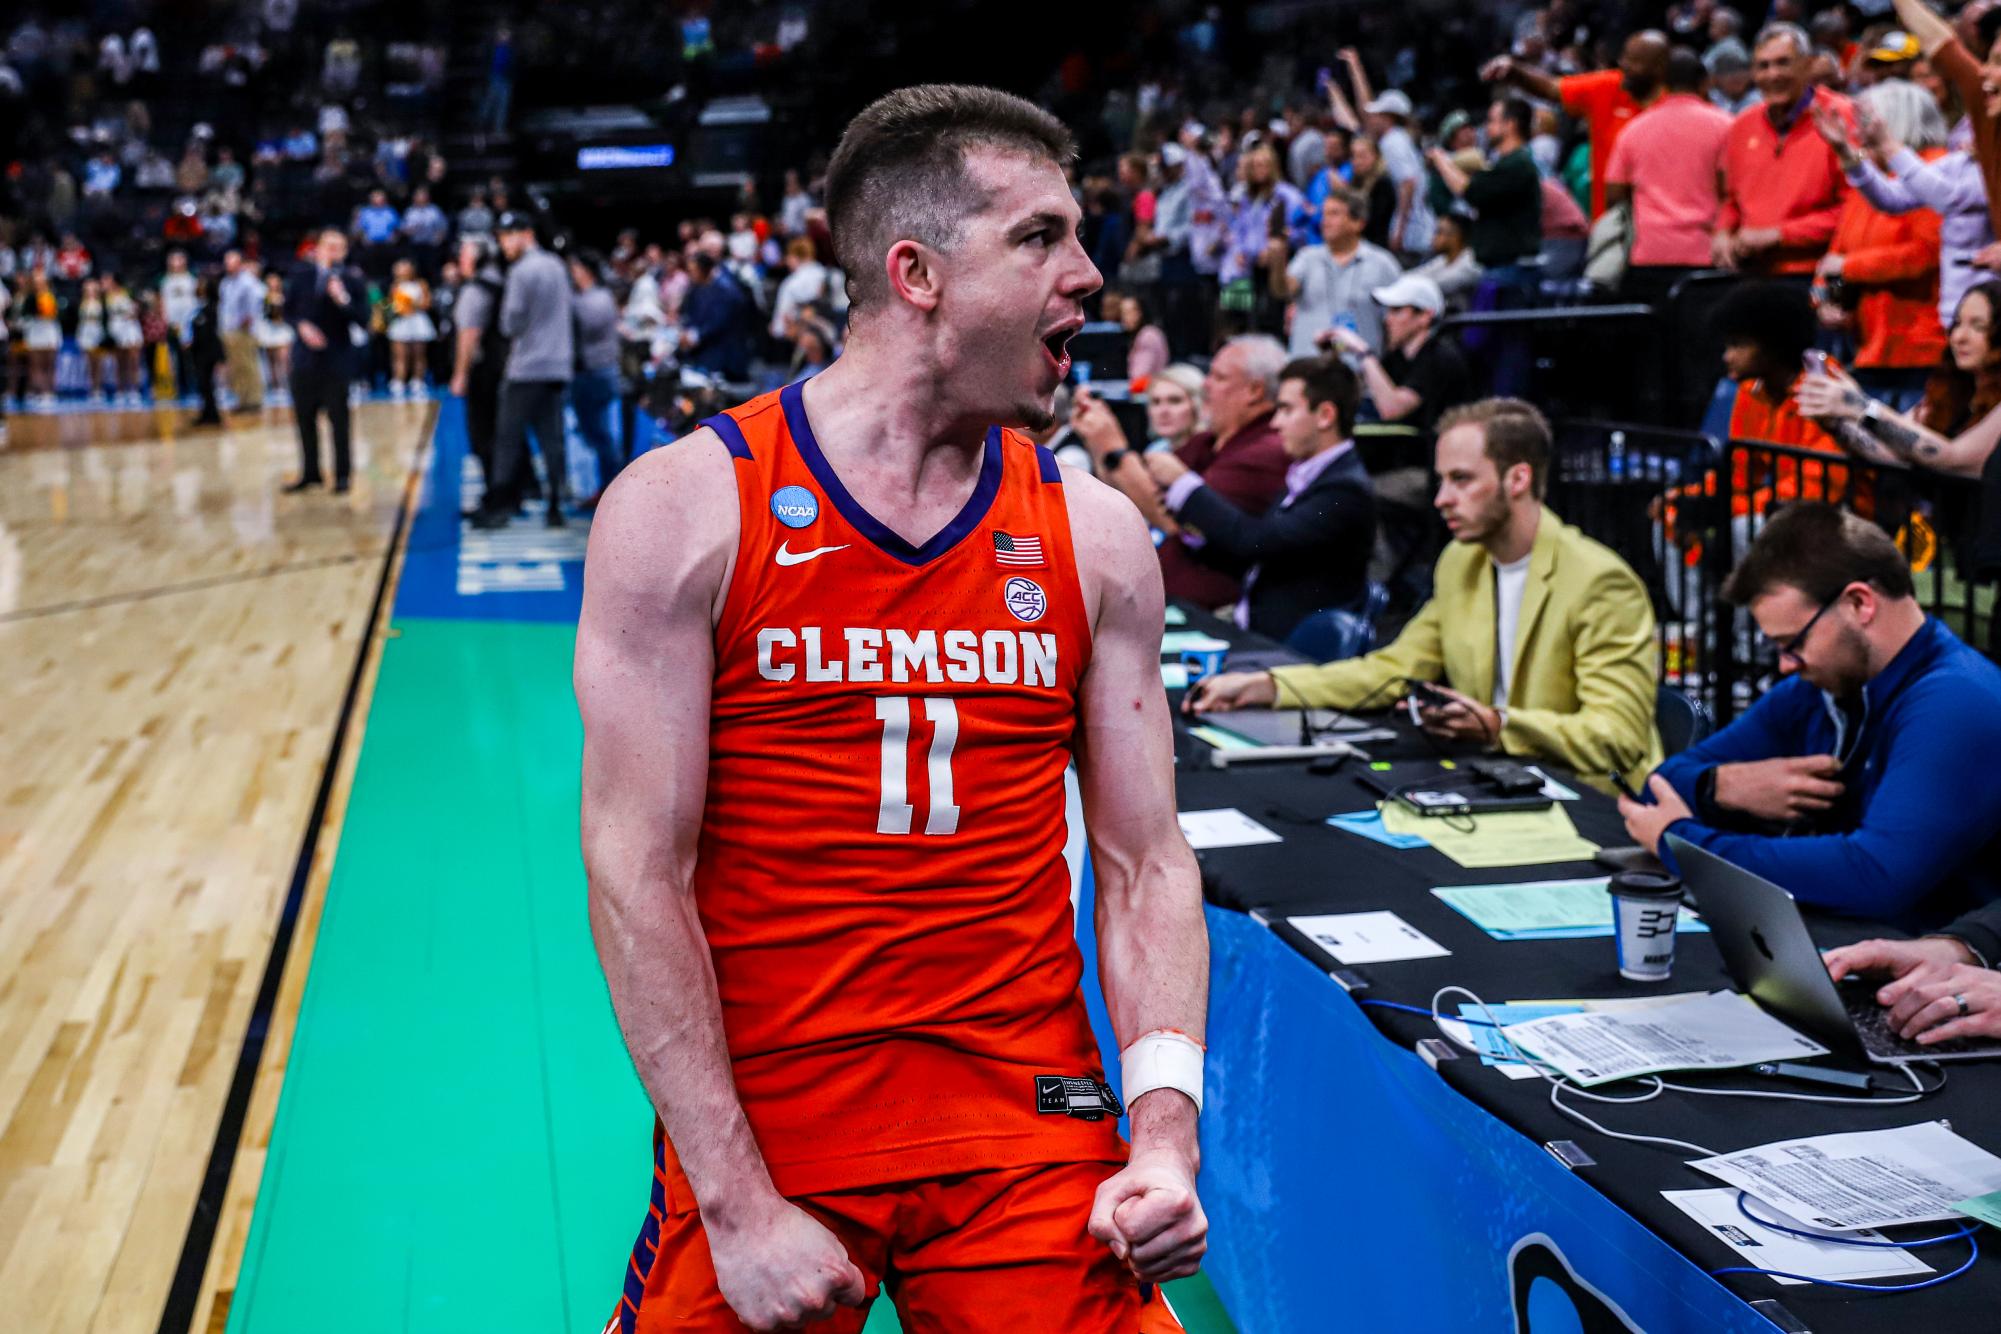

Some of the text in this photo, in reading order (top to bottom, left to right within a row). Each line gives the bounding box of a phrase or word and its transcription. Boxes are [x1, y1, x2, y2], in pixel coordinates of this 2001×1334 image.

[778, 505, 815, 517] NCAA
[1011, 591, 1041, 602] ACC
[757, 627, 1056, 687] CLEMSON
[875, 696, 960, 835] 11
